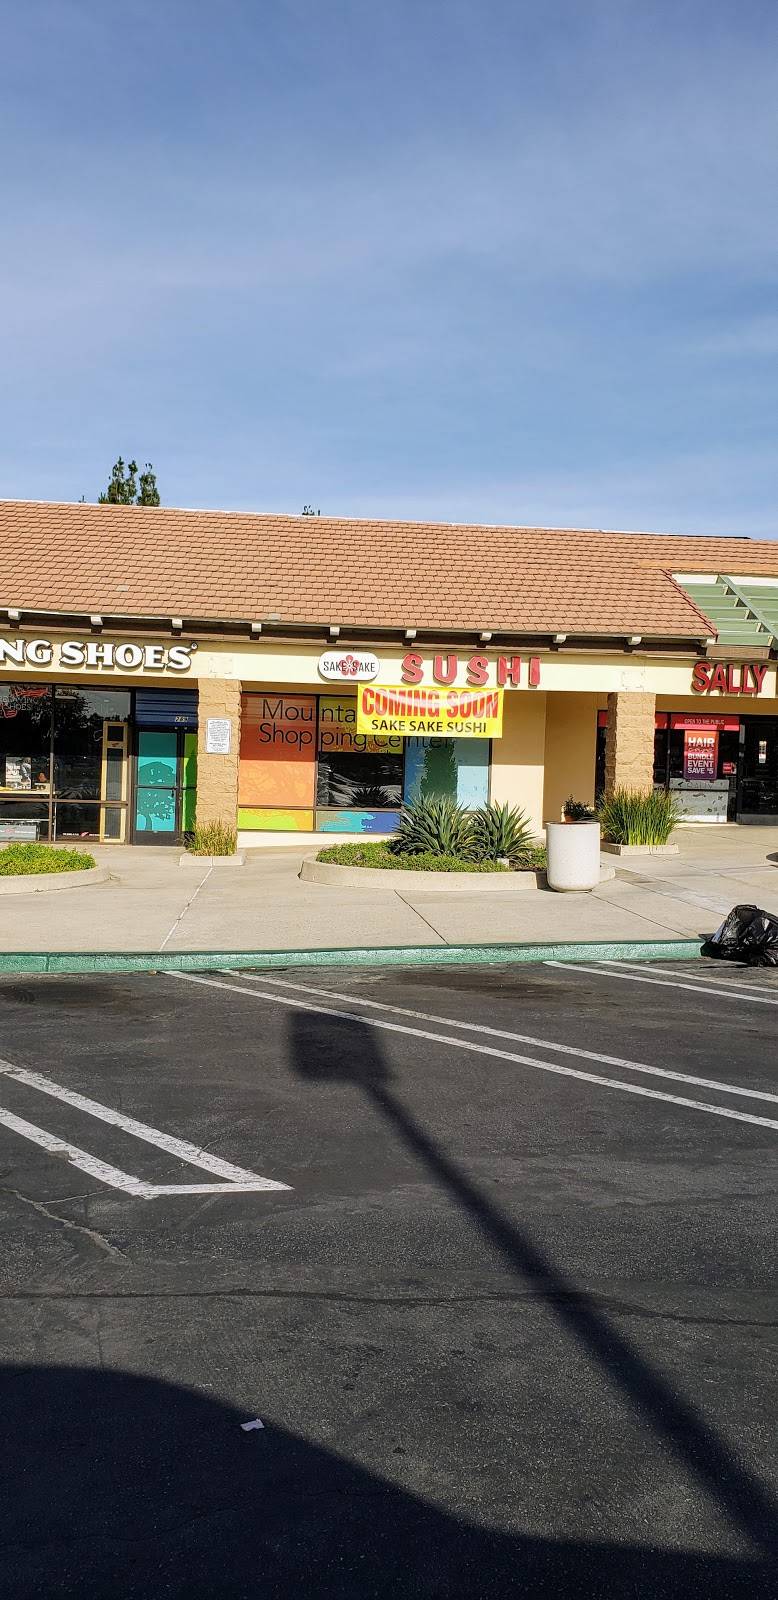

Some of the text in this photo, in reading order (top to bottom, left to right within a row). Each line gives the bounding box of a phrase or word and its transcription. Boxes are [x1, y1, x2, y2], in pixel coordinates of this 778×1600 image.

[60, 641, 192, 670] SHOES
[323, 661, 376, 673] SAKE SAKE
[402, 653, 540, 686] SUSHI
[693, 662, 768, 693] SALLY
[262, 698, 356, 722] Mounta
[362, 687, 499, 719] COMING SOON
[259, 722, 367, 752] Shopping
[371, 719, 487, 734] SAKE SAKE SUSHI
[688, 737, 715, 747] HAIR
